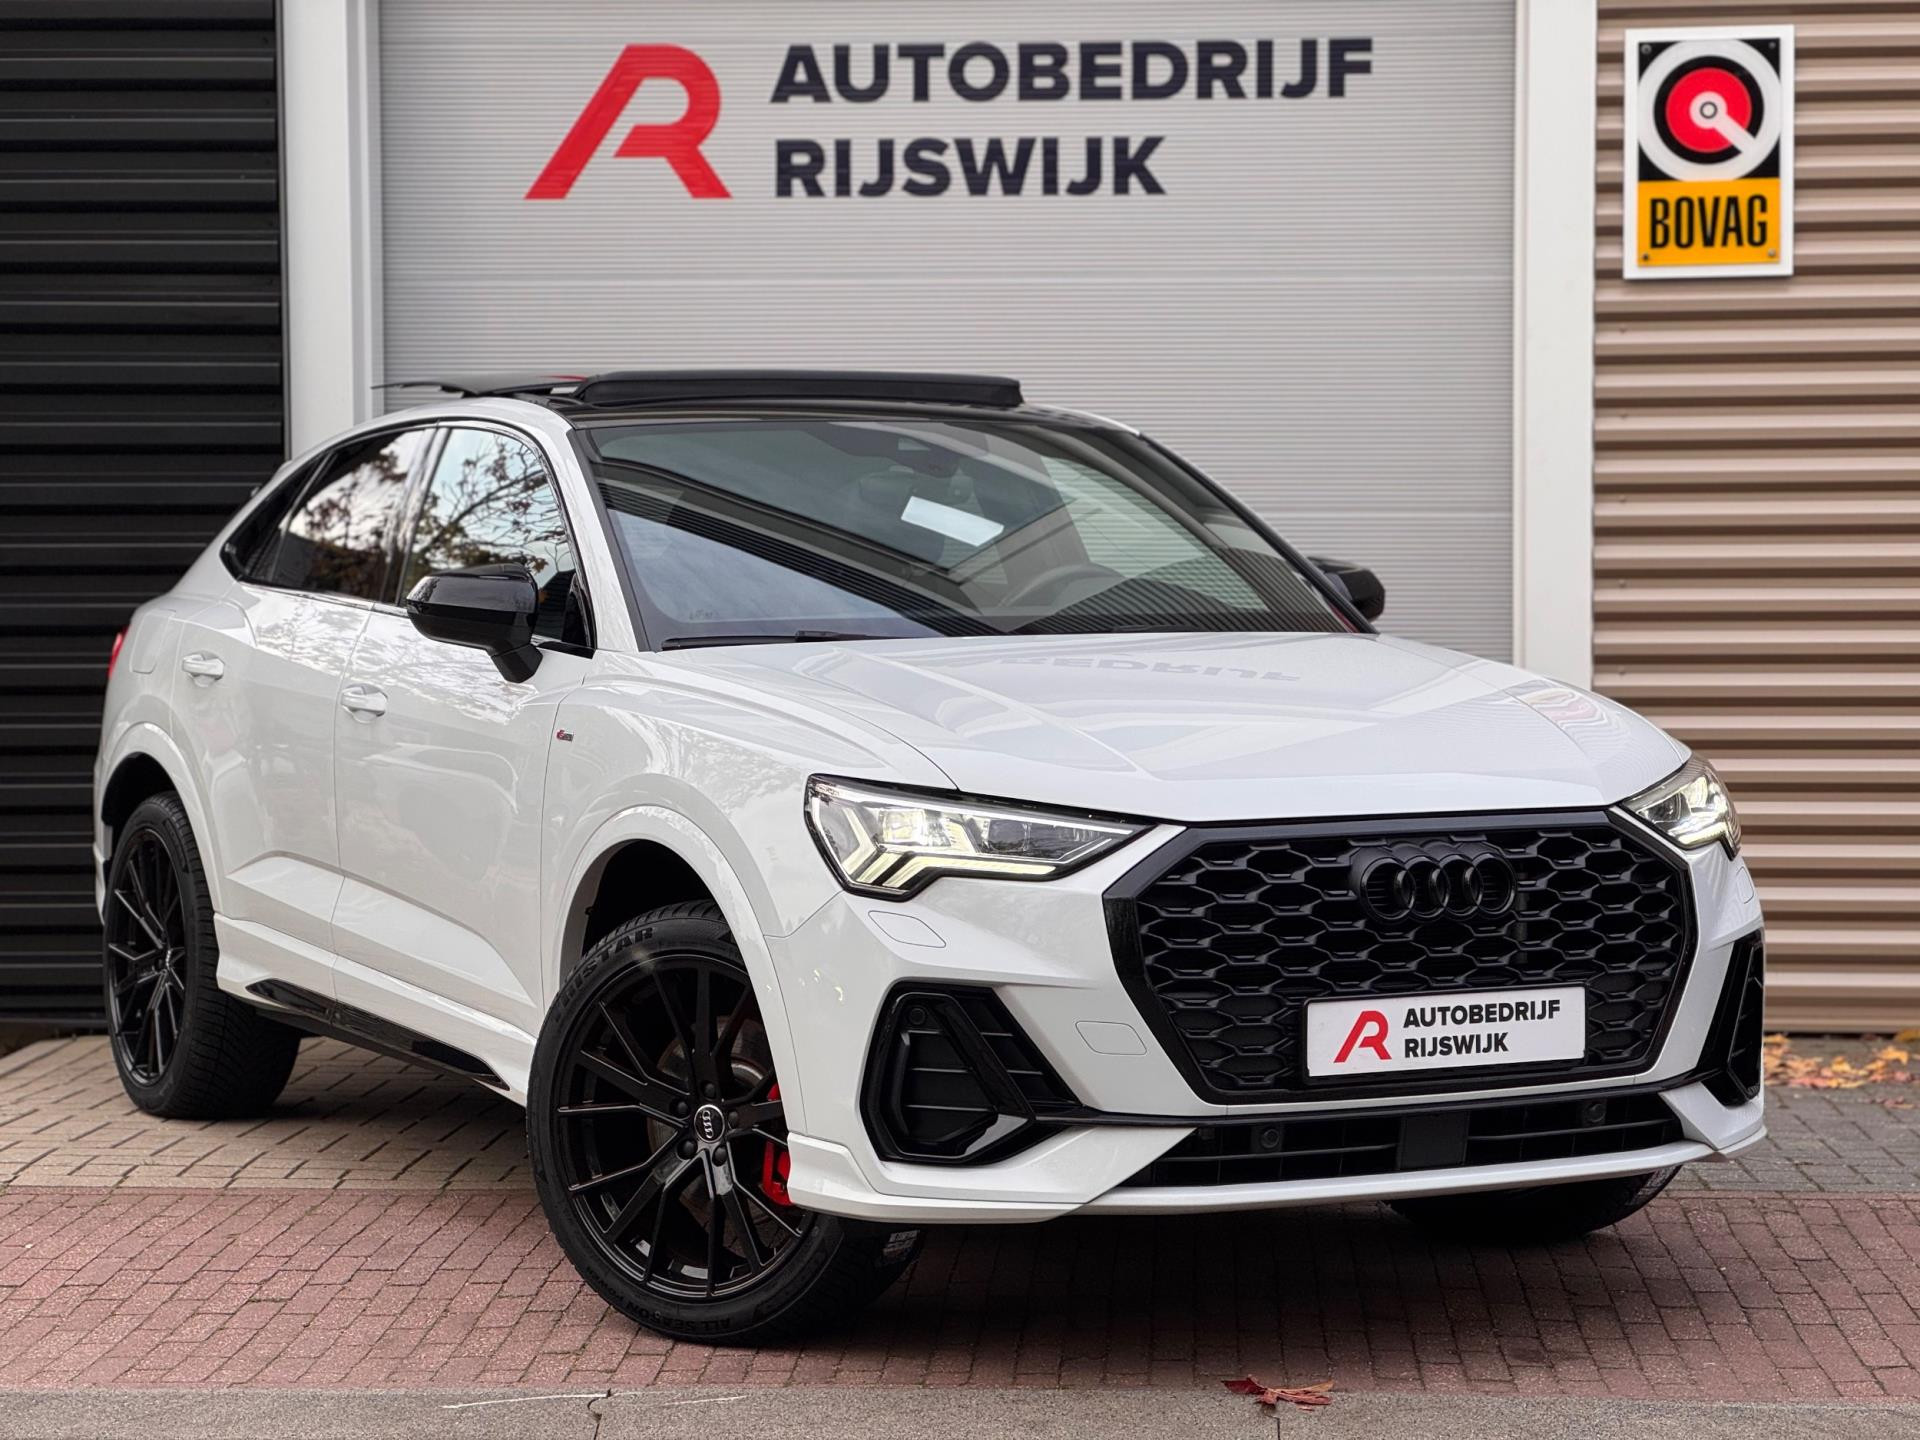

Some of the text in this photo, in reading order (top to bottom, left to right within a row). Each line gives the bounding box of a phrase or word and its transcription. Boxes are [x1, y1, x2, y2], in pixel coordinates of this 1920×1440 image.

[771, 38, 1373, 103] AUTOBEDRIJF
[775, 136, 1165, 198] RIJSWIJK
[1650, 193, 1767, 249] BOVAG
[1403, 999, 1560, 1028] AUTOBEDRIJF
[1404, 1032, 1509, 1058] RIJSWIJK
